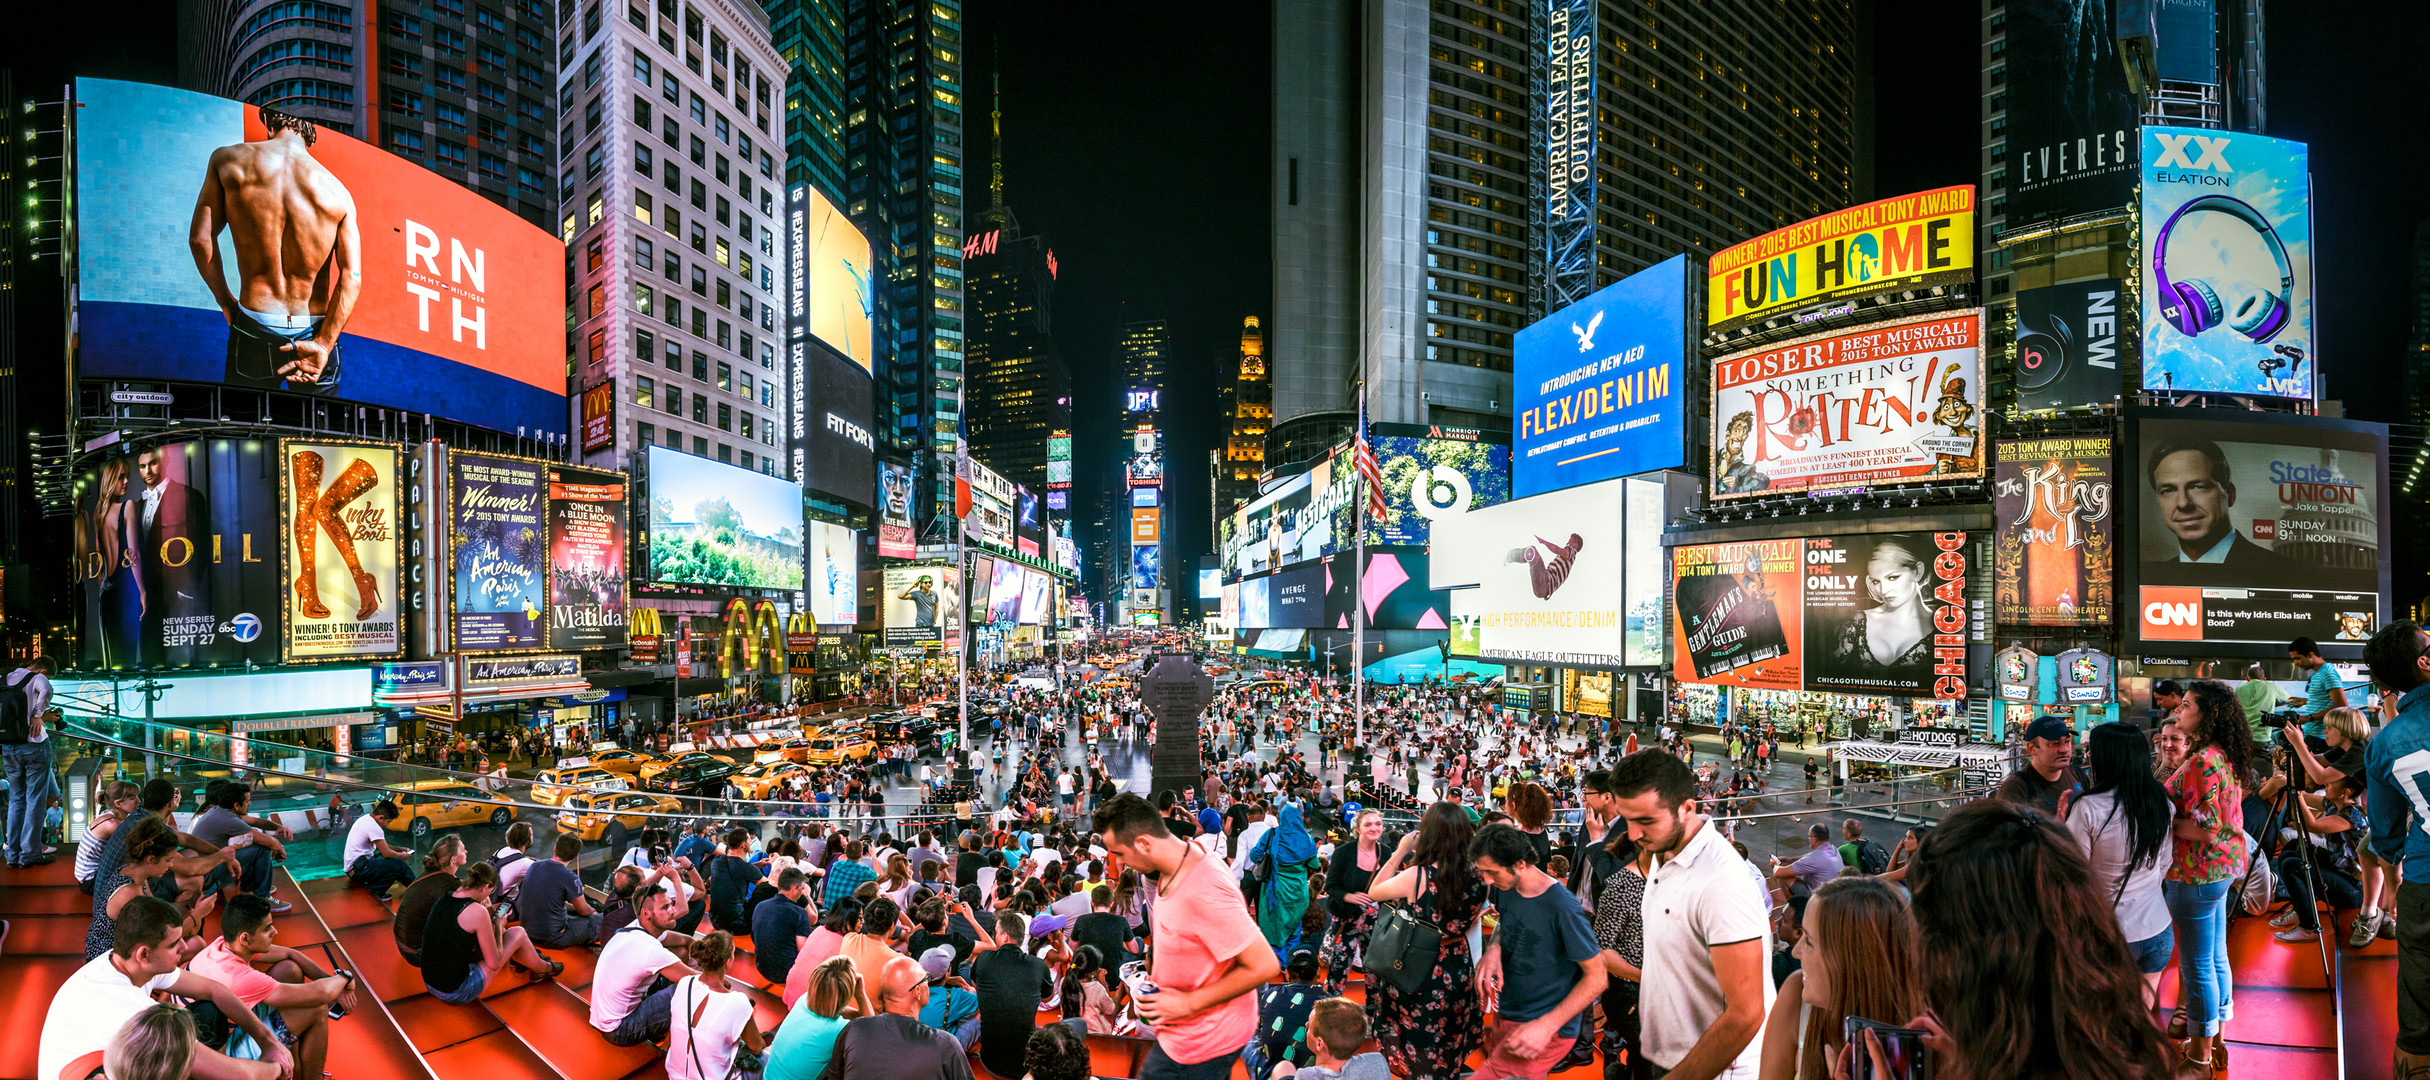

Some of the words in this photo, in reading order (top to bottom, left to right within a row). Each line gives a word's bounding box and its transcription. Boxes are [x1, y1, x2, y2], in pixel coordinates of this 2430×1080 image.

[1551, 7, 1569, 86] EAGLE
[1571, 35, 1591, 183] OUTFITTERS
[1550, 90, 1567, 218] AMERICAN
[1712, 241, 1758, 274] WINNER!
[1760, 231, 1786, 258] 2015
[1789, 221, 1819, 249] BEST
[1820, 205, 1877, 239] MUSICAL
[1880, 198, 1916, 224] TONY
[1919, 188, 1969, 217] AWARD
[962, 229, 1000, 260] H&M
[1725, 252, 1797, 316] FUN
[1816, 217, 1951, 291] HOME
[406, 269, 440, 287] TOMMY
[451, 286, 485, 304] HILFIGER
[2087, 290, 2116, 370] NEW
[1722, 341, 1834, 386] LOSER!
[1841, 334, 1882, 351] BEST
[1886, 321, 1968, 343] MUSICAL!
[1840, 350, 1868, 362] 2015
[1872, 344, 1911, 358] TONY
[1914, 335, 1967, 353] AWARD
[1540, 361, 1599, 396] INTRODUCING
[1600, 353, 1622, 374] NEW
[1623, 345, 1645, 365] AEO
[1766, 356, 1915, 394] SOMETHING
[2257, 377, 2303, 395] JVC
[117, 393, 134, 401] city
[136, 394, 169, 402] outdoor
[1522, 363, 1669, 440] FLEX/DENIM
[588, 415, 607, 428] OPEN
[827, 411, 845, 435] FIT
[846, 420, 868, 447] FOR
[590, 423, 604, 439] 24
[585, 433, 610, 448] HOURS
[1998, 442, 2016, 454] 2015
[2017, 442, 2040, 453] TONY
[2041, 440, 2072, 452] AWARD
[2073, 438, 2111, 450] WINNER!
[1830, 449, 1872, 461] FUNNIEST
[1874, 446, 1913, 457] MUSICAL
[1998, 453, 2018, 461] BEST
[2019, 452, 2051, 460] REVIVAL
[2074, 449, 2111, 457] MUSICAL
[473, 465, 490, 474] MOST
[1766, 467, 1798, 477] COMEDY
[1820, 461, 1847, 471] LEAST
[1848, 458, 1865, 468] 400
[2269, 460, 2332, 485] State
[461, 484, 538, 512] Winner!
[1996, 477, 2025, 497] The
[2014, 463, 2113, 526] King
[2278, 481, 2355, 505] UNION
[462, 508, 475, 523] 4
[476, 512, 492, 521] 2015
[493, 512, 511, 522] TONY
[510, 513, 537, 524] AWARDS
[559, 510, 566, 518] A
[567, 510, 588, 520] BLUE
[594, 505, 604, 514] IN
[2294, 503, 2319, 512] Jake
[2321, 504, 2355, 514] Tapper
[411, 458, 425, 609] PALACE
[2021, 522, 2060, 546] and
[2059, 504, 2085, 552] I
[2254, 525, 2273, 534] CNN
[2279, 519, 2326, 531] SUNDAY
[1806, 539, 1832, 549] THE
[2279, 529, 2289, 541] 9
[2305, 533, 2336, 543] NOON
[160, 533, 262, 567] OIL
[482, 540, 501, 563] An
[1676, 546, 1714, 566] BEST
[1717, 541, 1796, 564] MUSICAL!
[1807, 549, 1847, 564] ONE
[470, 555, 535, 586] American
[1677, 566, 1695, 577] 2014
[1696, 565, 1716, 576] TONY
[1717, 563, 1745, 575] AWARD
[1762, 561, 1795, 573] WINNER
[1806, 565, 1832, 575] THE
[481, 577, 522, 599] Paris
[1807, 575, 1858, 590] ONLY
[552, 603, 624, 629] Matilda
[1481, 612, 1501, 628] HIGH
[1503, 610, 1616, 628] PERFORMANCE/DENIM
[1934, 532, 1967, 700] CHICAGO
[2002, 606, 2034, 614] LINCOLN
[2144, 602, 2198, 627] CNN
[2216, 610, 2233, 618] this
[2234, 611, 2251, 620] why
[2253, 611, 2272, 619] Idris
[2273, 611, 2292, 619] Elba
[2293, 611, 2312, 620] isn't
[163, 617, 184, 625] NEW
[185, 615, 215, 624] SERIES
[294, 623, 330, 635] WINNER!
[332, 623, 337, 633] 6
[339, 622, 361, 633] TONY
[361, 621, 394, 632] AWARDS
[1688, 586, 1744, 653] GENTLEMAN'S
[1692, 615, 1701, 626] A
[2207, 619, 2235, 628] Bond?
[163, 623, 215, 636] SUNDAY
[218, 625, 237, 633] abc
[1712, 625, 1747, 648] GUIDE
[163, 634, 197, 647] SEPT
[200, 633, 216, 645] 27
[1480, 648, 1523, 660] AMERICAN
[1525, 650, 1554, 662] EAGLE
[1555, 651, 1620, 666] OUTFITTERS
[1817, 676, 1919, 688] CHICAGOTHEMUSICAL.COM
[1912, 731, 1931, 742] HOT
[1931, 731, 1957, 742] DOGS
